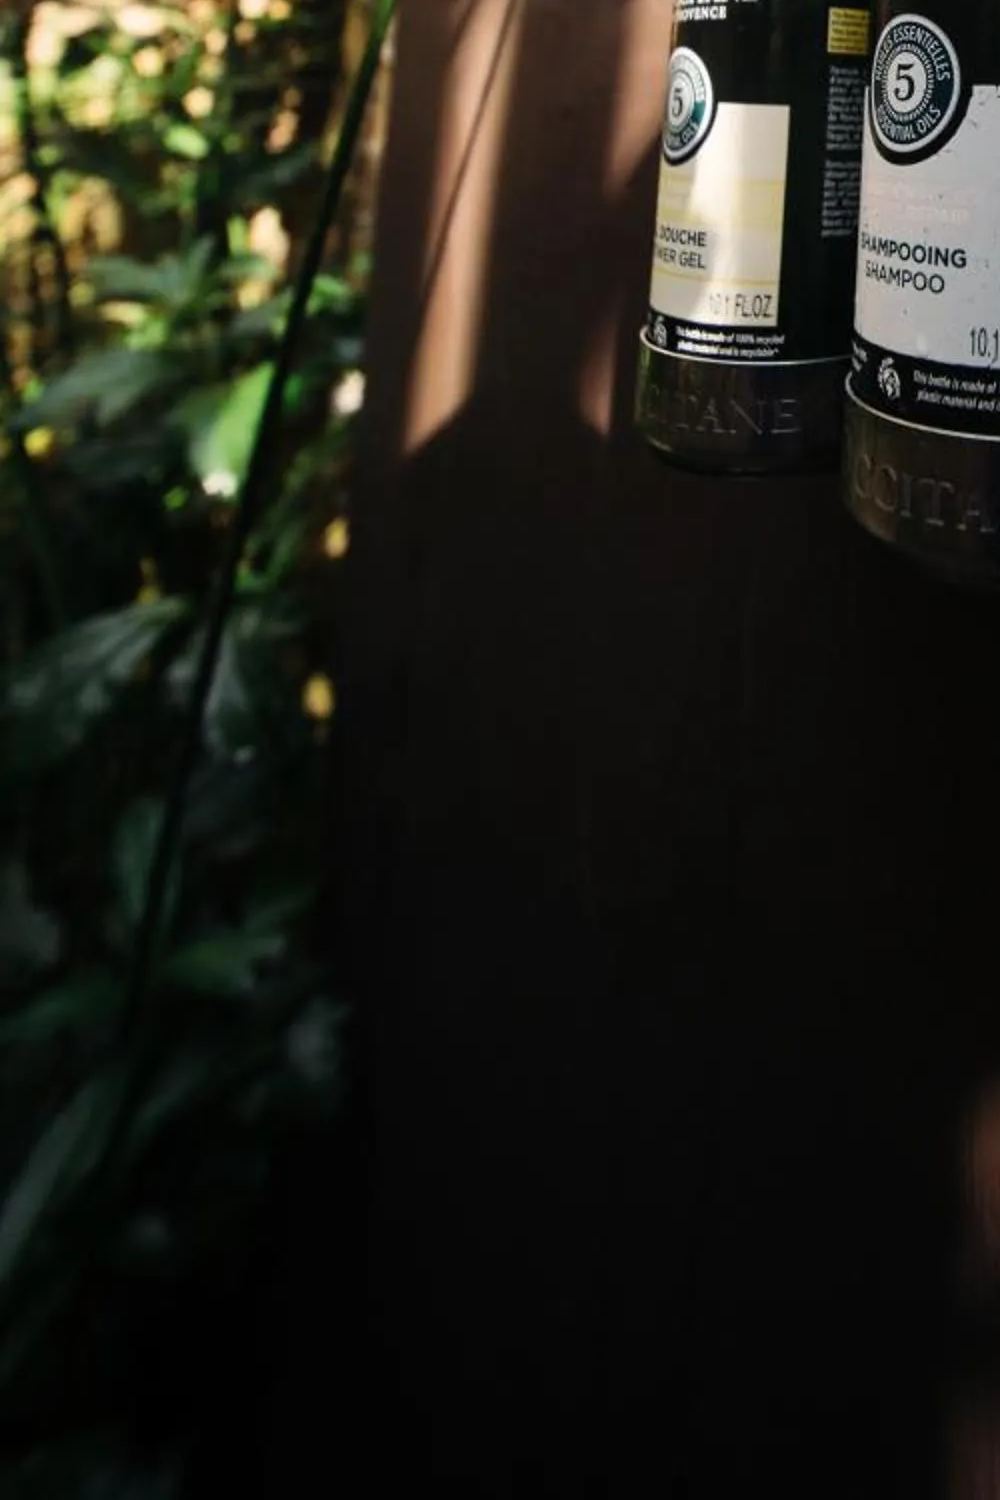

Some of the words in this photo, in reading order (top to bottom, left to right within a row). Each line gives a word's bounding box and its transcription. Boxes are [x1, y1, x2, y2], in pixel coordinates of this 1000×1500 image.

[892, 24, 952, 82] ESSENTIELLES
[893, 63, 915, 101] 5
[670, 87, 684, 117] 5
[916, 102, 942, 133] OILS
[679, 250, 706, 270] GEL
[860, 231, 968, 269] SHAMPOOING
[864, 259, 946, 294] SHAMPOO
[970, 327, 1000, 362] 10.1
